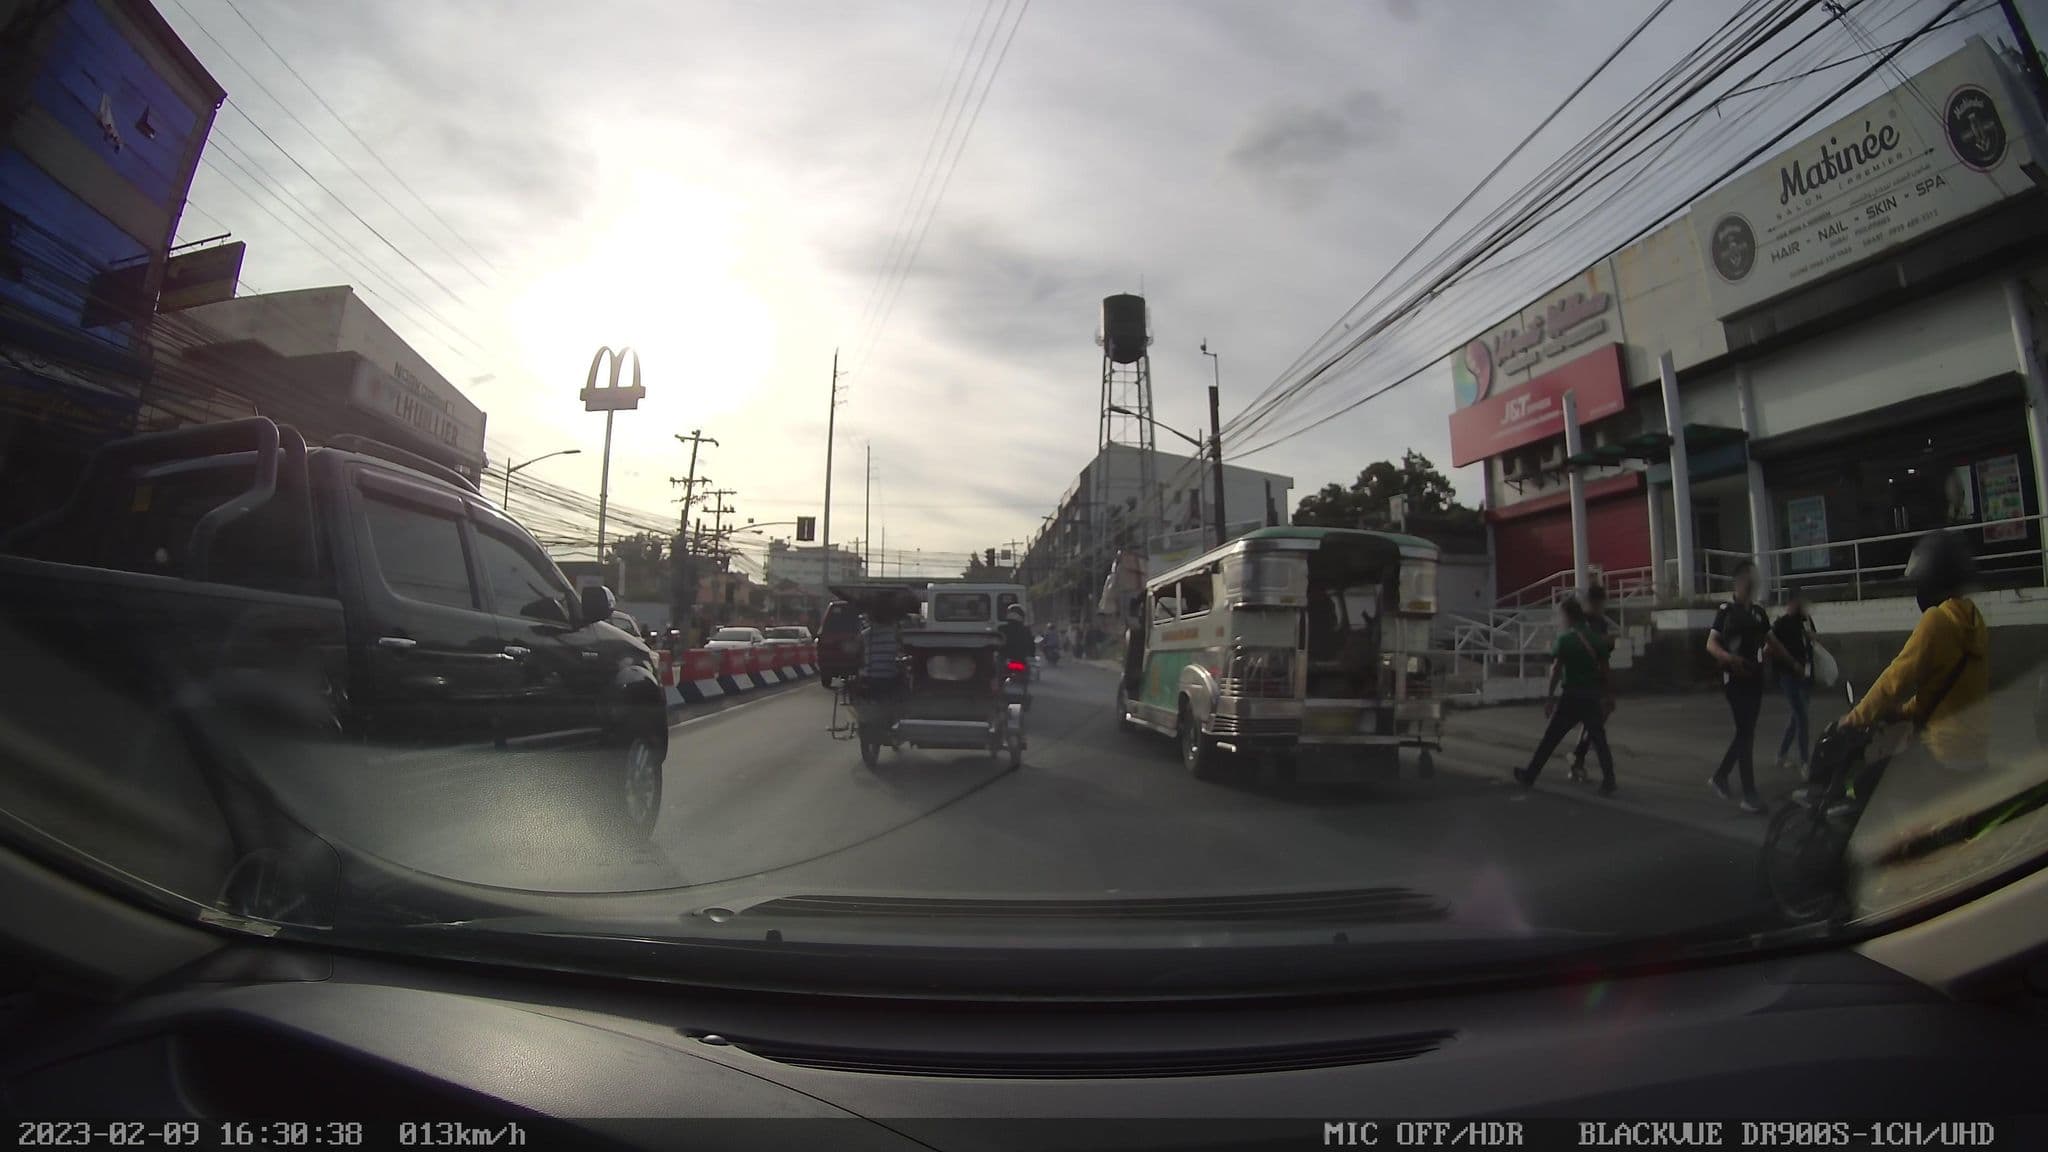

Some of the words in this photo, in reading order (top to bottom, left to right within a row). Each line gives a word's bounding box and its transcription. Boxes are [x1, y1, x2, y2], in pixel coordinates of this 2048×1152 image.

[1780, 121, 1900, 205] Matinée
[1770, 241, 1800, 264] HAIR
[1818, 220, 1849, 242] NAIL
[1866, 195, 1898, 219] SKIN
[1916, 175, 1946, 196] SPA
[1500, 391, 1532, 425] J&T
